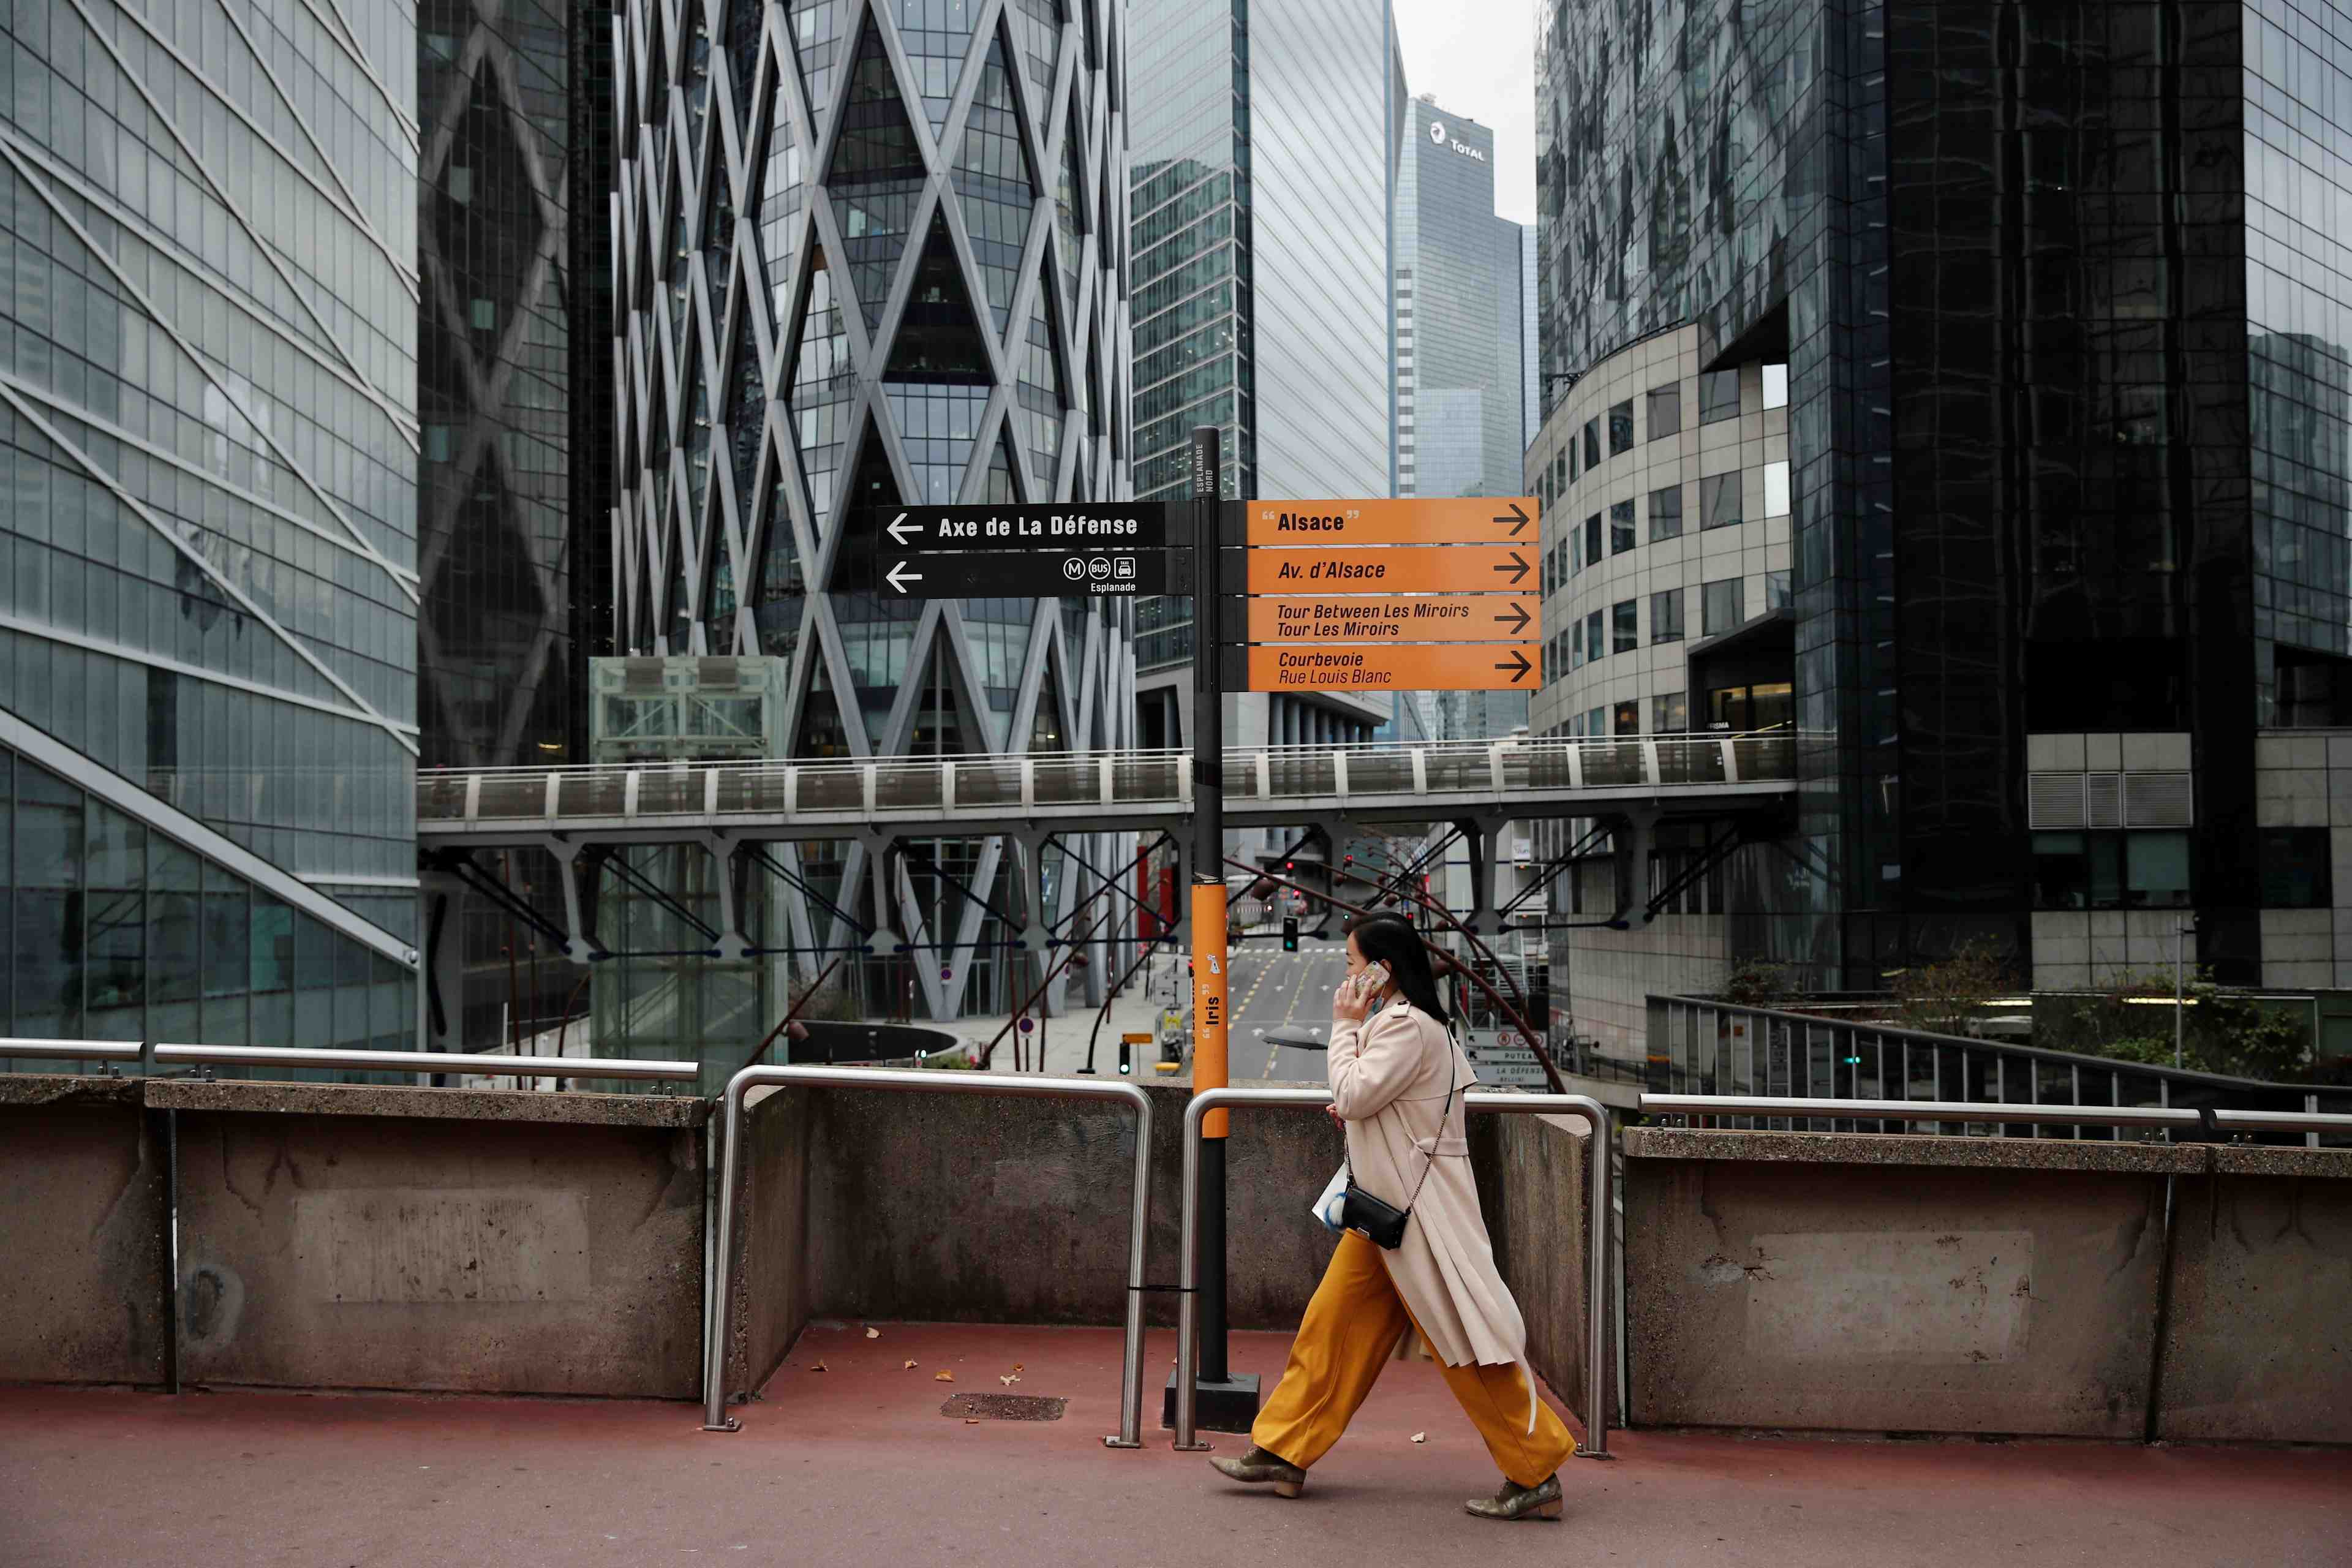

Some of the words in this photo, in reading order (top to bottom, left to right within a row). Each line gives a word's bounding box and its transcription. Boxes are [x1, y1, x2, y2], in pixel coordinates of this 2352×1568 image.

[1450, 139, 1485, 162] TOTAL
[938, 518, 978, 537] Axe
[986, 517, 1010, 537] de
[1019, 516, 1042, 535] La
[1050, 514, 1137, 535] Défense
[1091, 564, 1108, 573] BUS
[1278, 562, 1303, 579] Av.
[1310, 561, 1385, 578] d’Alsace
[1091, 582, 1136, 594] Esplanade
[1278, 605, 1310, 619] Tour
[1314, 604, 1379, 619] Between
[1384, 604, 1409, 618] Les
[1414, 603, 1469, 617] Miroirs
[1278, 622, 1310, 636] Tour
[1314, 622, 1340, 636] Les
[1343, 621, 1399, 636] Miroirs
[1279, 652, 1363, 667] Courbevoie
[1279, 669, 1306, 684] Rue
[1310, 669, 1348, 684] Louis
[1352, 669, 1392, 684] Blanc
